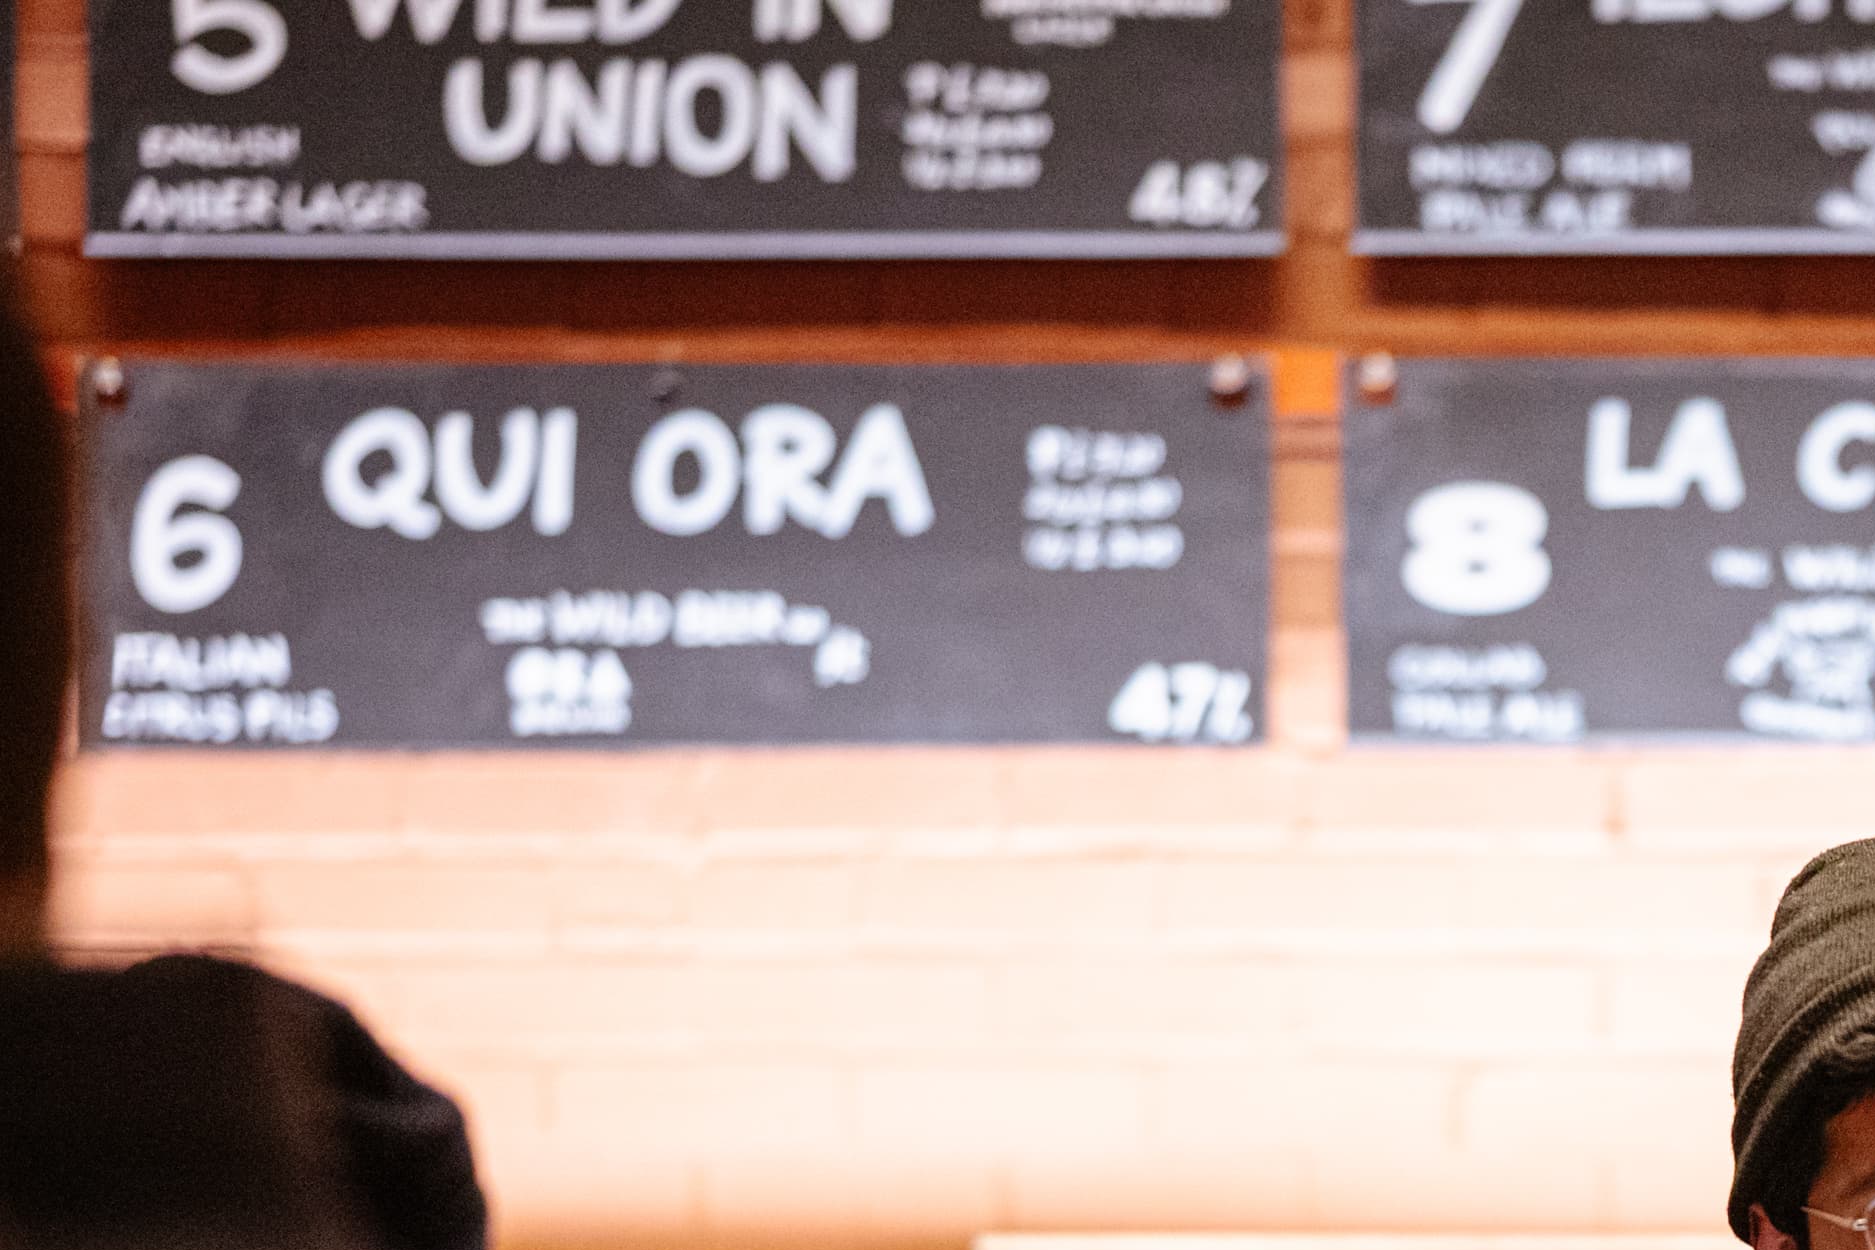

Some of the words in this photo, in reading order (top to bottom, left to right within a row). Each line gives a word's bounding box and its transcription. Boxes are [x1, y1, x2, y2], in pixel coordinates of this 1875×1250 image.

[171, 0, 288, 94] 5
[1416, 0, 1523, 134] 7
[443, 53, 858, 183] UNION
[322, 407, 578, 540] QUI
[631, 404, 935, 539] ORA
[1584, 398, 1746, 512] LA
[129, 455, 243, 614] 6
[1400, 481, 1552, 616] 8
